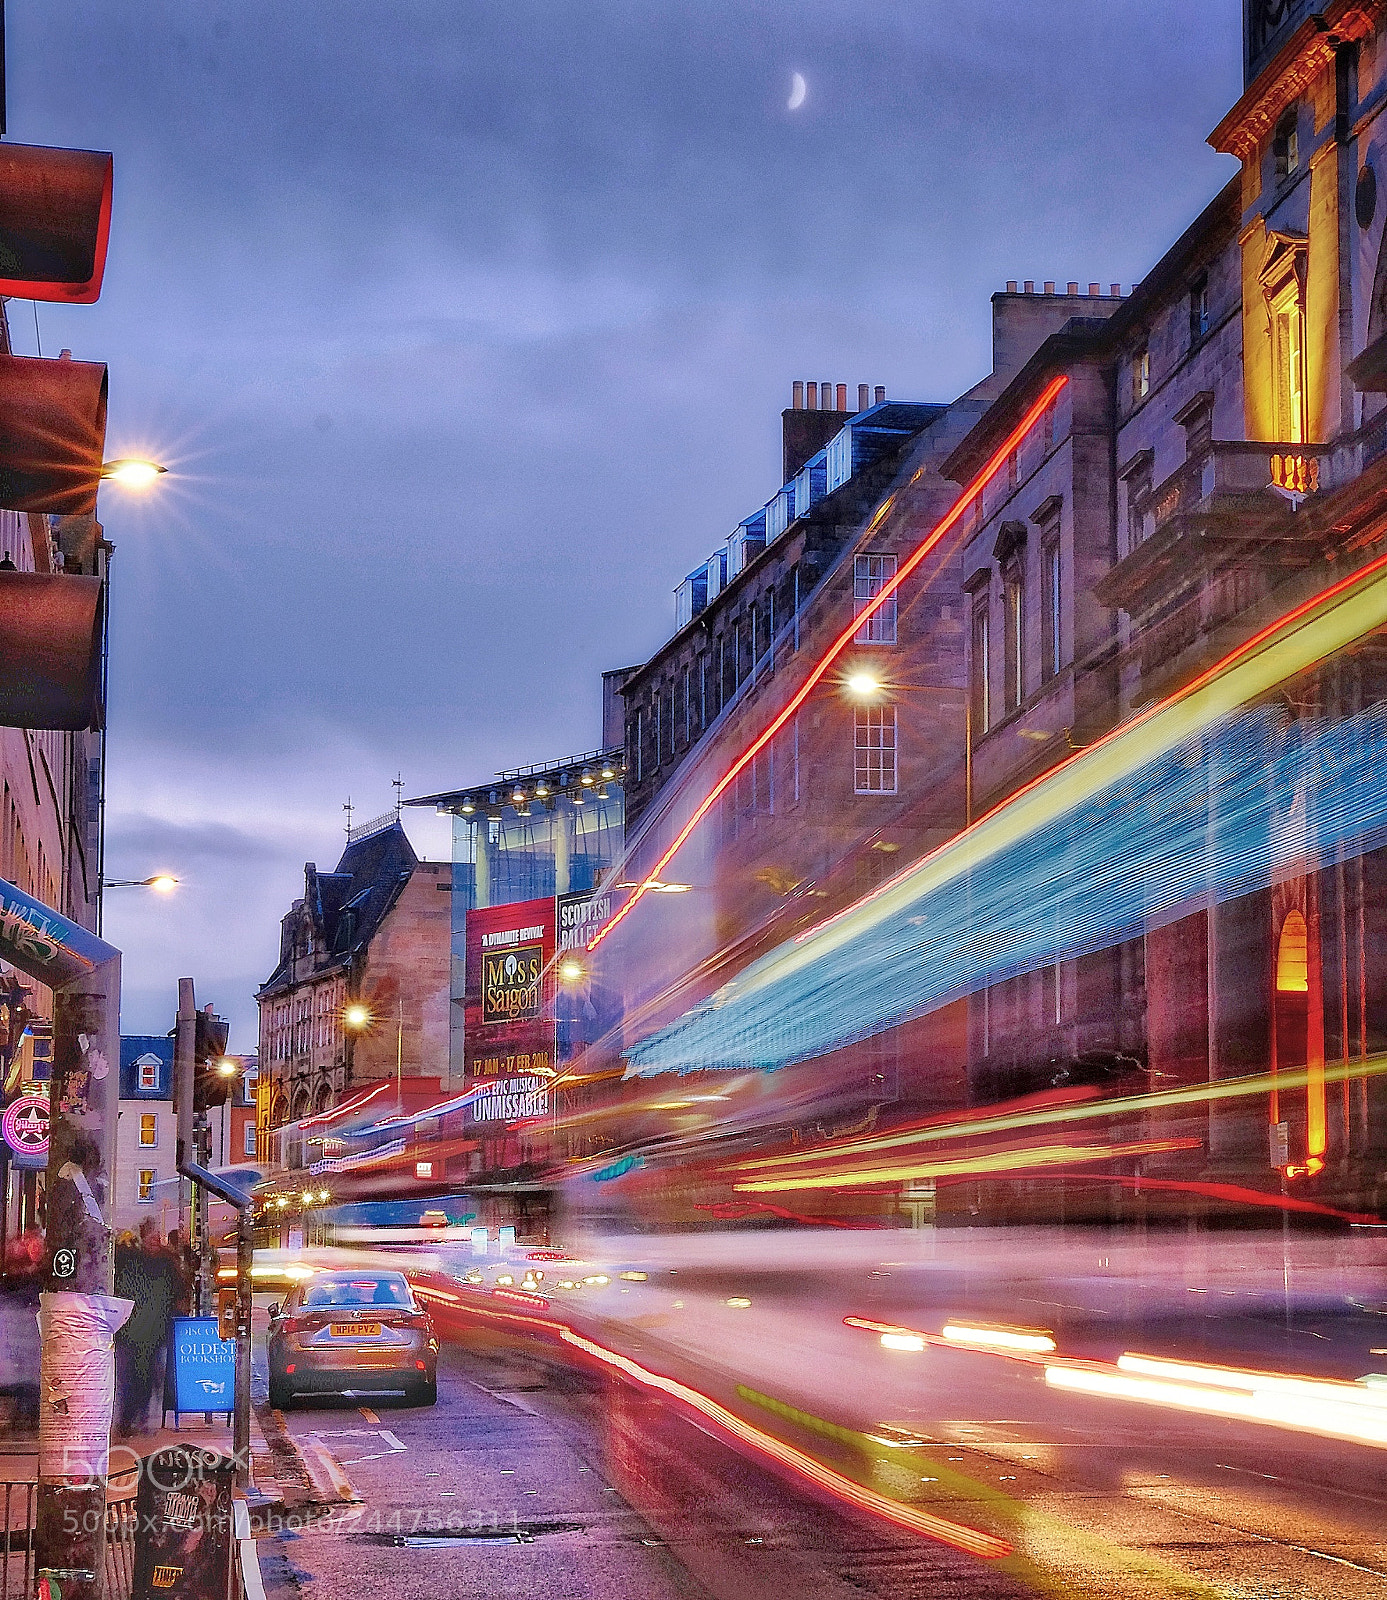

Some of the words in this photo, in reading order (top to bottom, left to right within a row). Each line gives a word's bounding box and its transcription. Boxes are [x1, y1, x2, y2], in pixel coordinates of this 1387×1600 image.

[561, 897, 611, 927] SCOTTISH
[488, 929, 519, 946] DYNAMITE
[561, 924, 599, 950] BALLET
[487, 985, 538, 1018] Saigon
[473, 1059, 482, 1076] 17
[483, 1057, 499, 1075] JAN
[506, 1055, 515, 1073] 17
[516, 1054, 530, 1070] FEB
[532, 1051, 549, 1068] 2018
[492, 1079, 509, 1096] EPIC
[509, 1075, 539, 1093] MUSICAL
[472, 1090, 549, 1122] UNMISSABLE!
[180, 1343, 236, 1355] OLDEST
